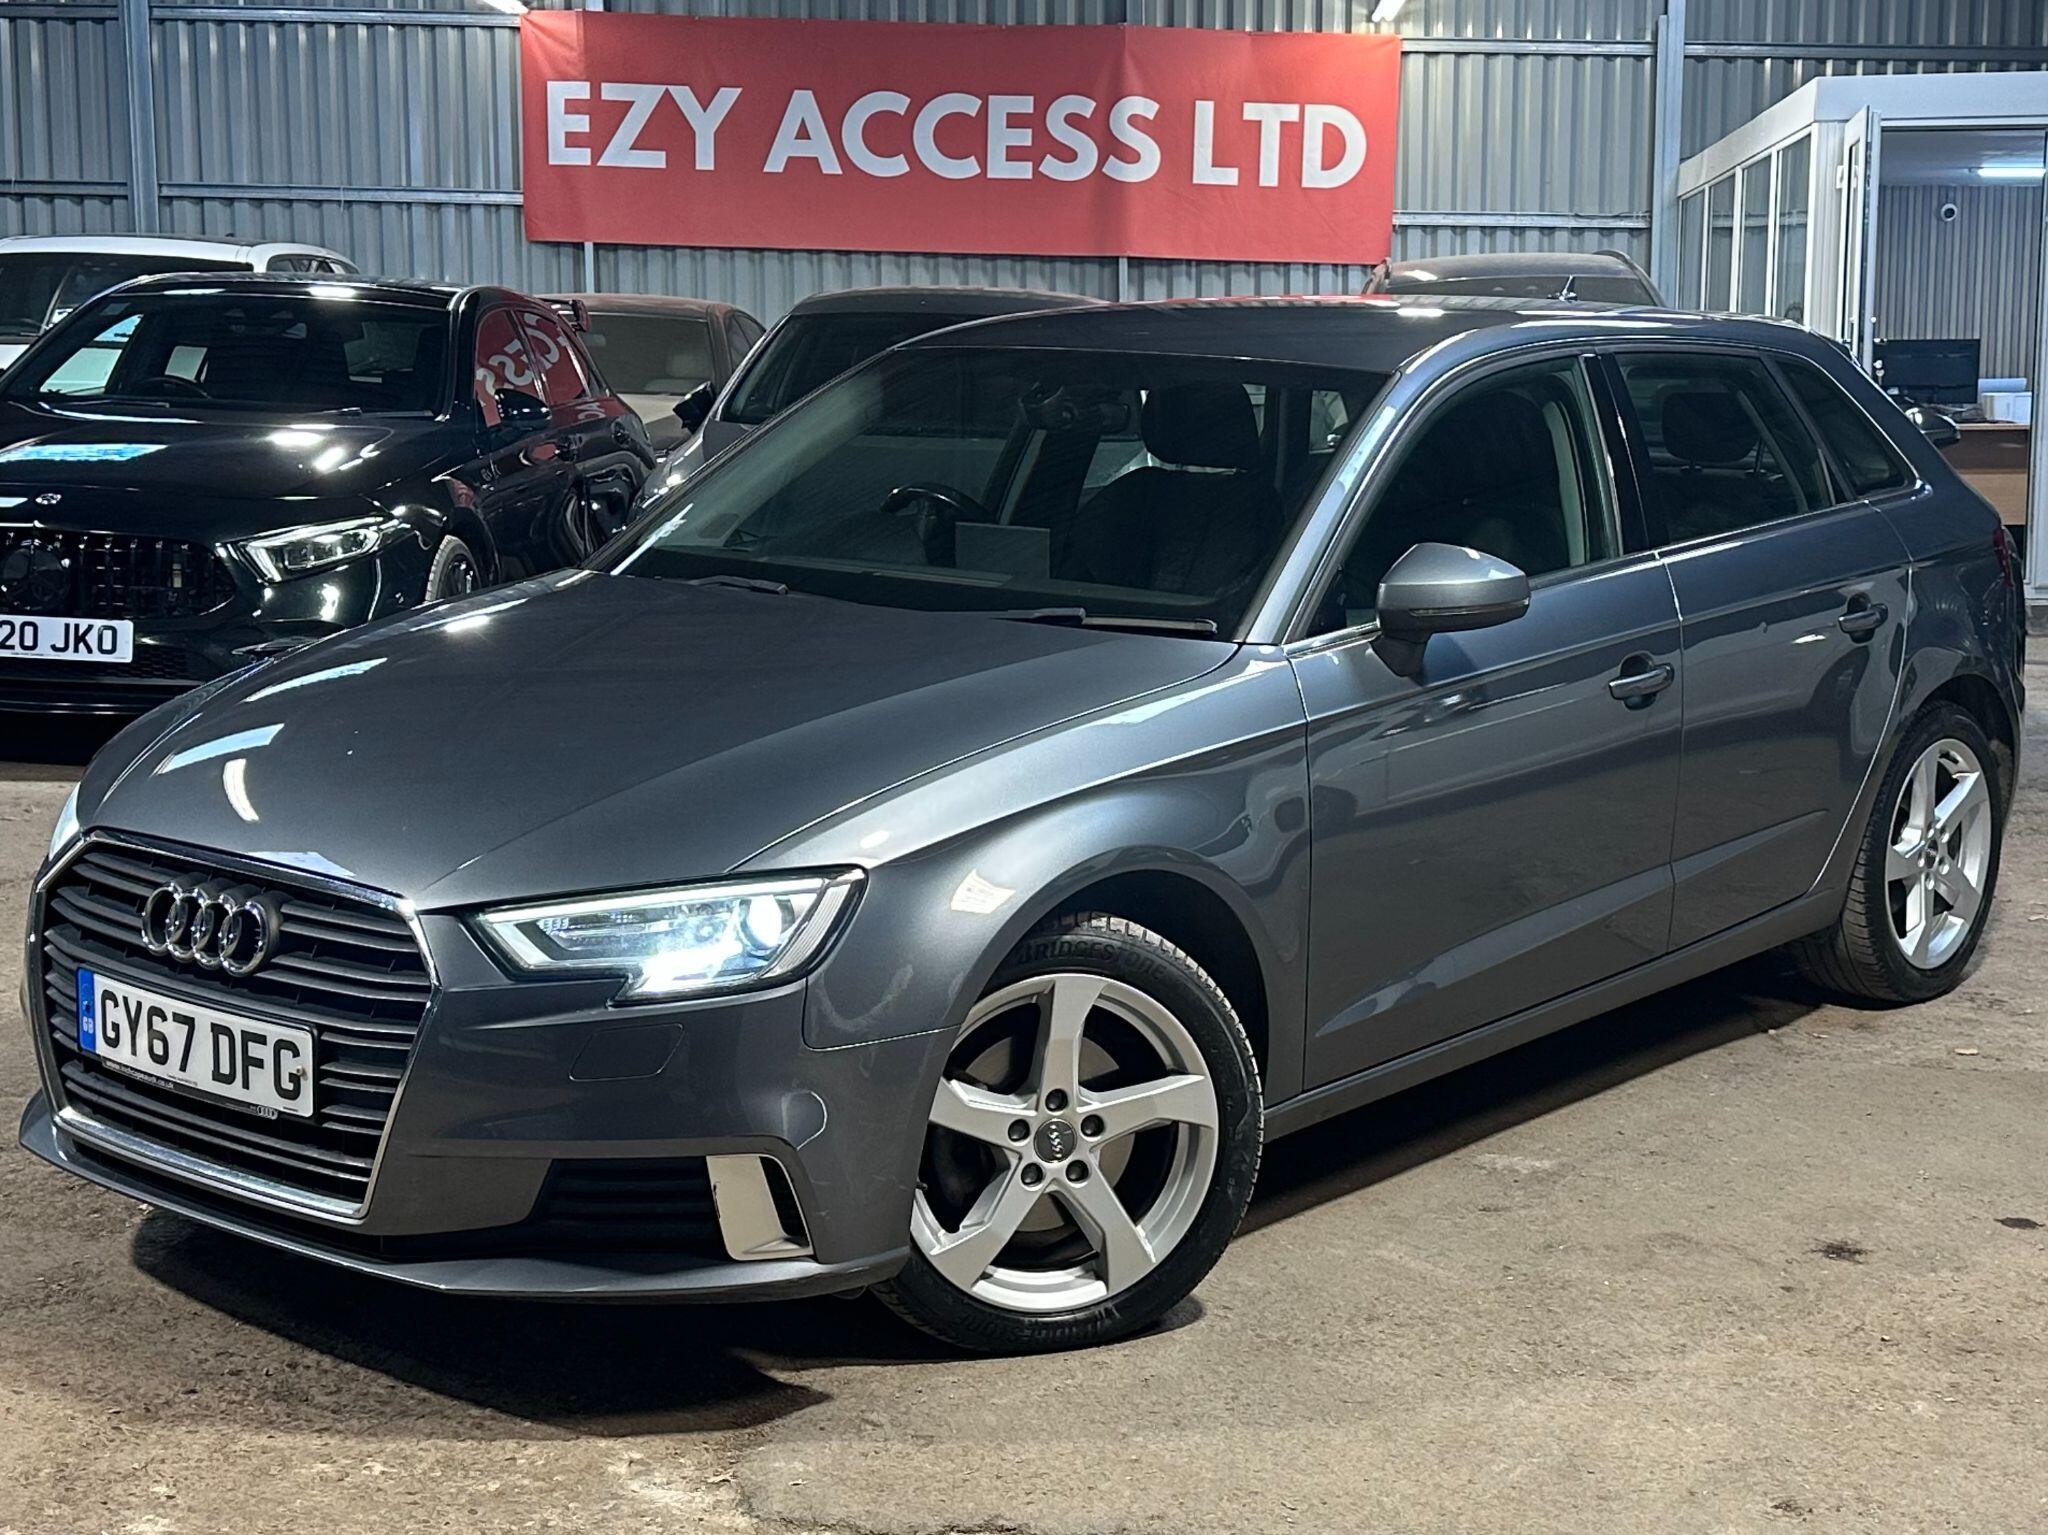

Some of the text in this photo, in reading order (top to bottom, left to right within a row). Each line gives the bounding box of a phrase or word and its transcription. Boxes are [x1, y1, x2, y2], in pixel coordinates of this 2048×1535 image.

[546, 80, 1368, 190] EZY ACCESS LTD
[50, 622, 118, 656] JKO
[101, 989, 302, 1102] GY67 DFG
